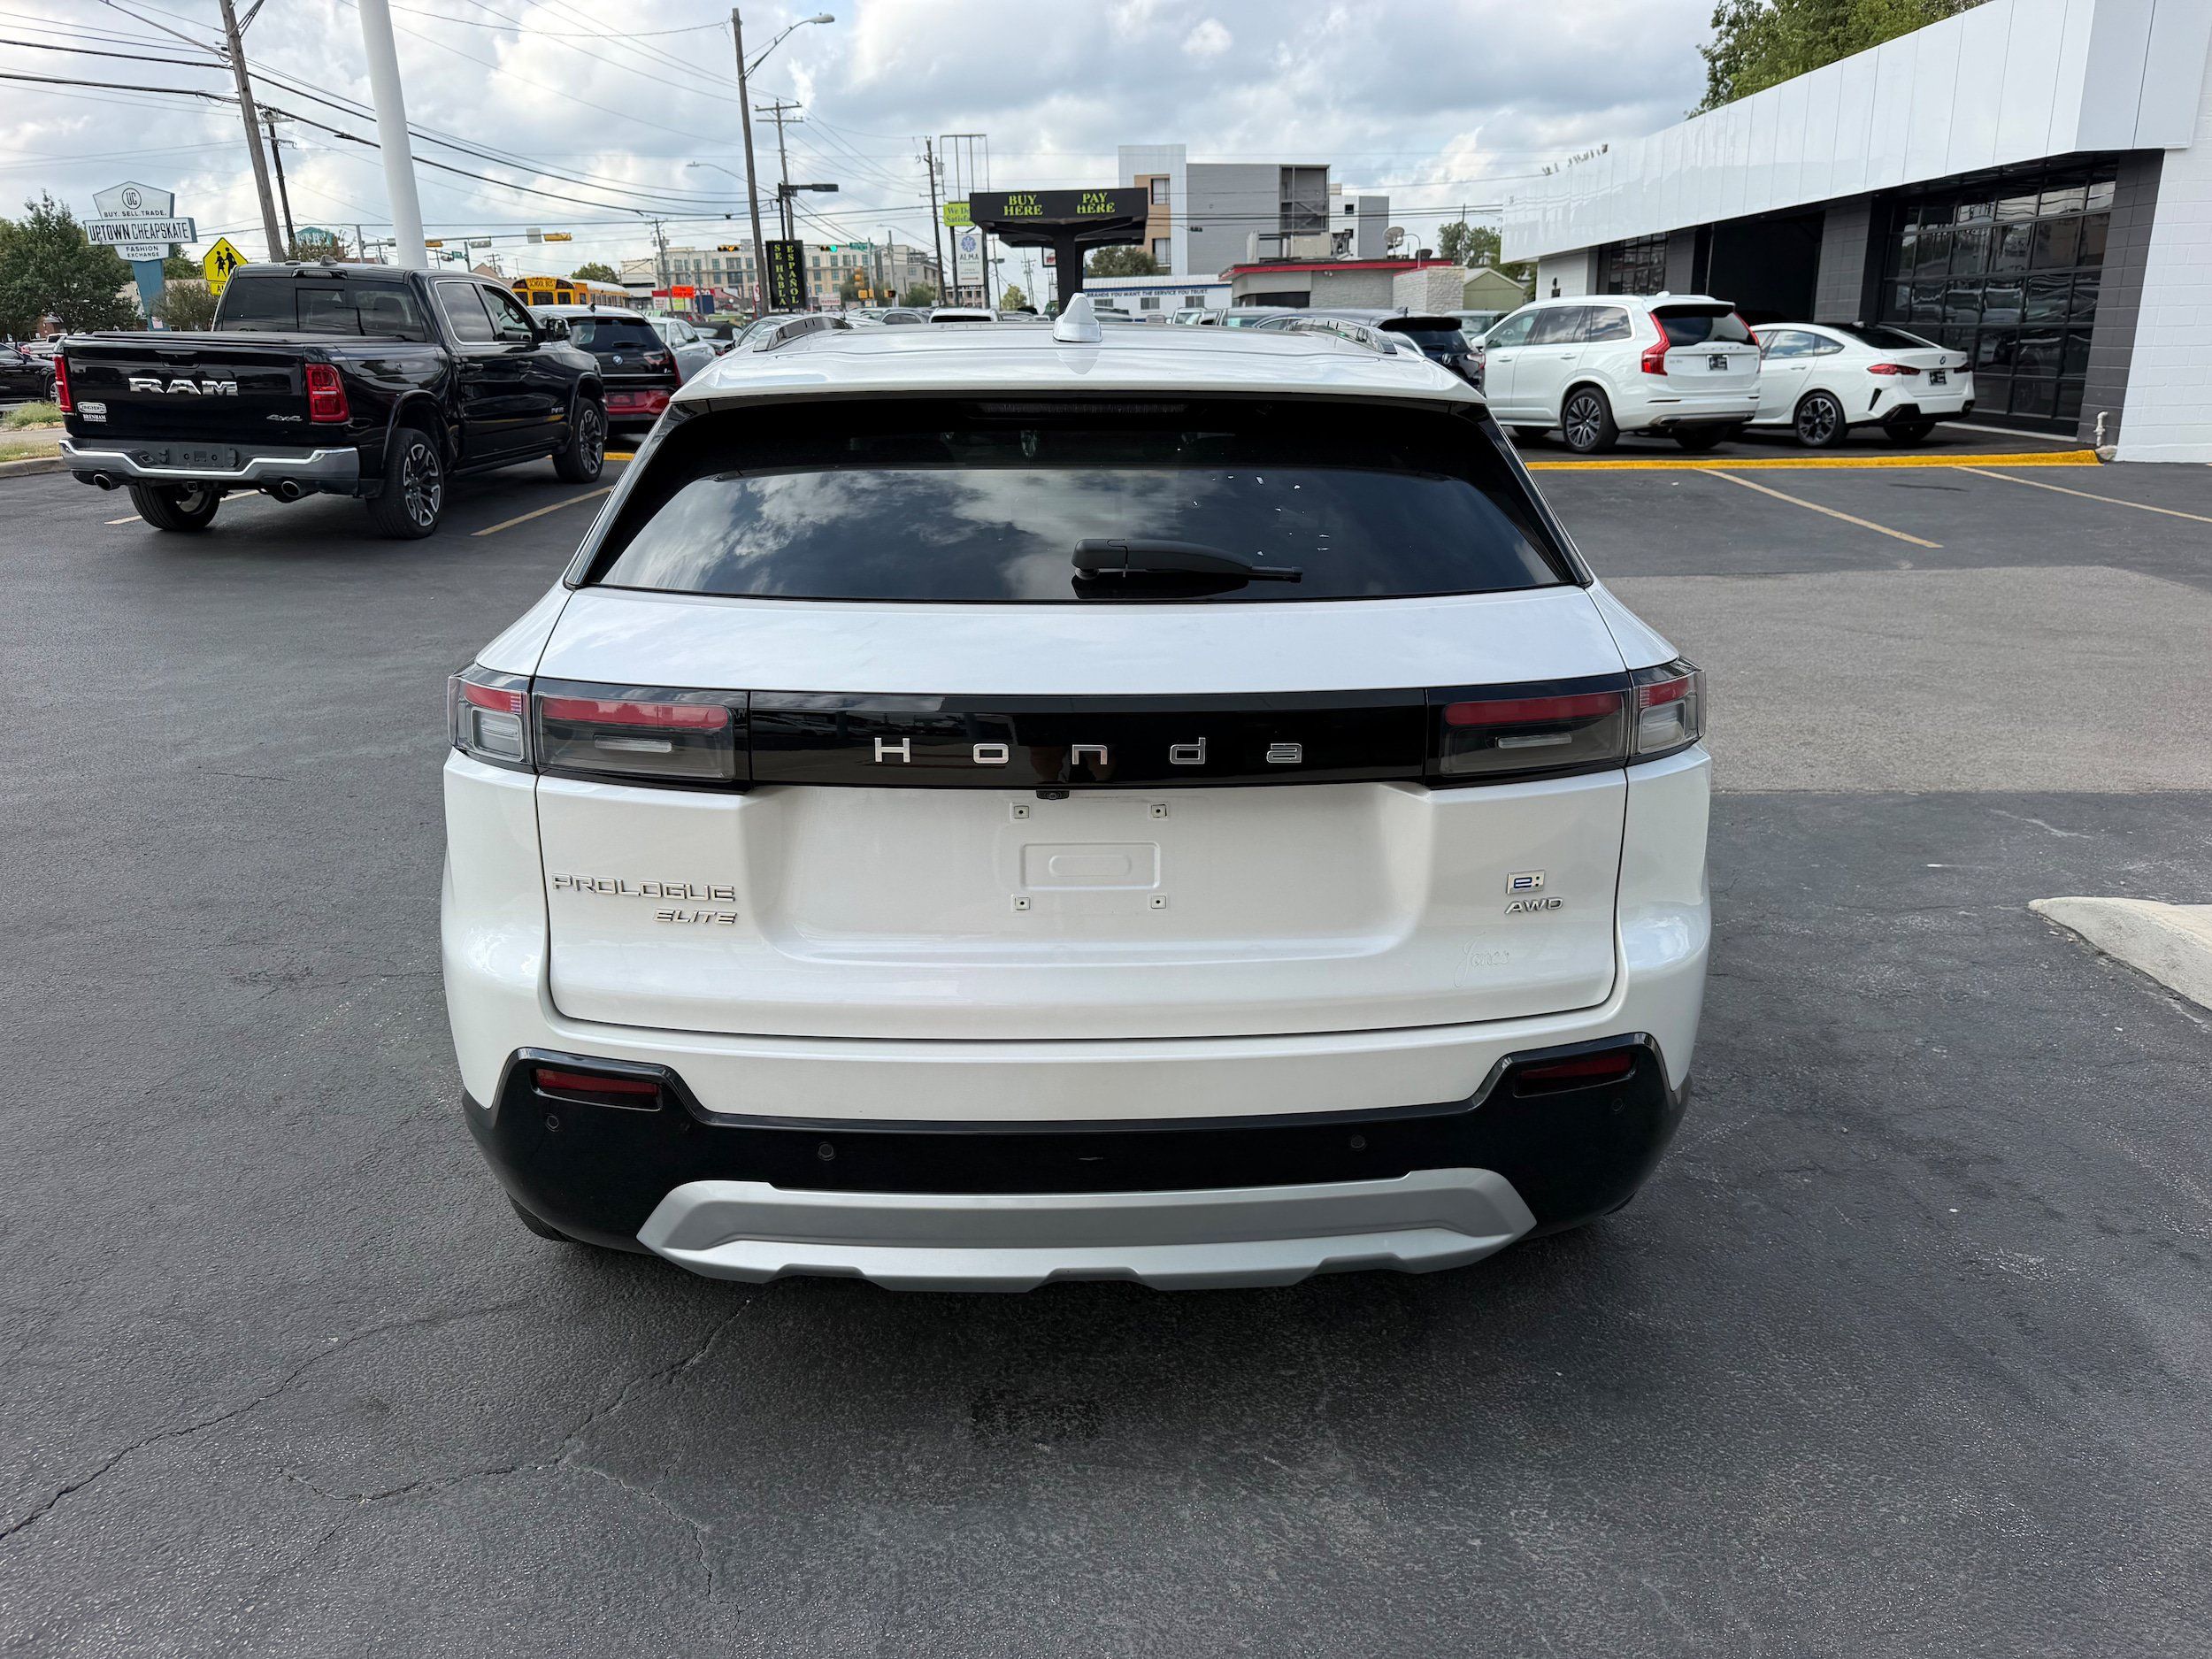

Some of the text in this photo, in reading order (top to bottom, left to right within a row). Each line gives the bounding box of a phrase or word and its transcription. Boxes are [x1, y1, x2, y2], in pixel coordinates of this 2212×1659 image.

[1009, 194, 1037, 205] BUY
[1082, 192, 1108, 204] PAY
[1003, 204, 1043, 216] HERE
[1077, 202, 1116, 214] HERE
[88, 222, 189, 242] UPTOWN CHEAPSKATE
[128, 377, 239, 396] RAM
[552, 872, 736, 902] PROLOGUE
[1504, 897, 1564, 914] AWD
[653, 908, 738, 925] ELITE
